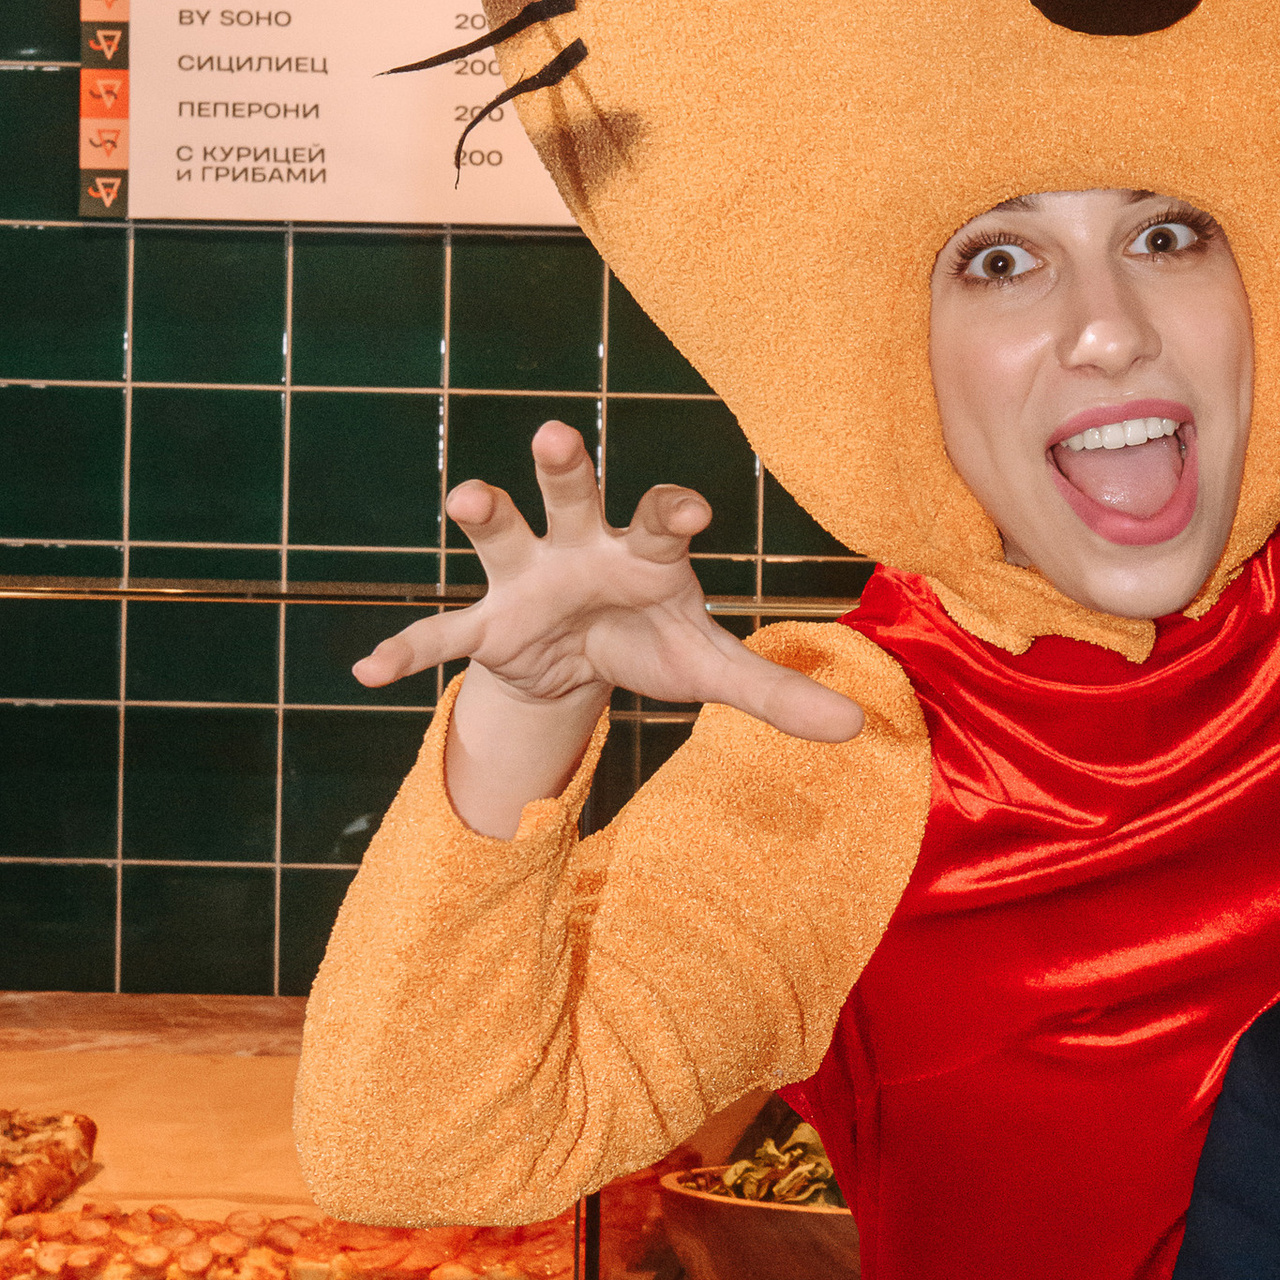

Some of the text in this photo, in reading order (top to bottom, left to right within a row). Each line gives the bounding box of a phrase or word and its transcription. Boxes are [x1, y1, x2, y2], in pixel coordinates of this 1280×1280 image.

[178, 9, 212, 26] BY
[219, 9, 293, 27] SOHO
[177, 54, 501, 76] СИЦИЛИЕЦ 200
[177, 101, 505, 122] ПЕПЕРОНИ 200
[176, 144, 503, 166] С КУРИЦЕЙ 200
[201, 166, 327, 184] ГРИБАМИ
